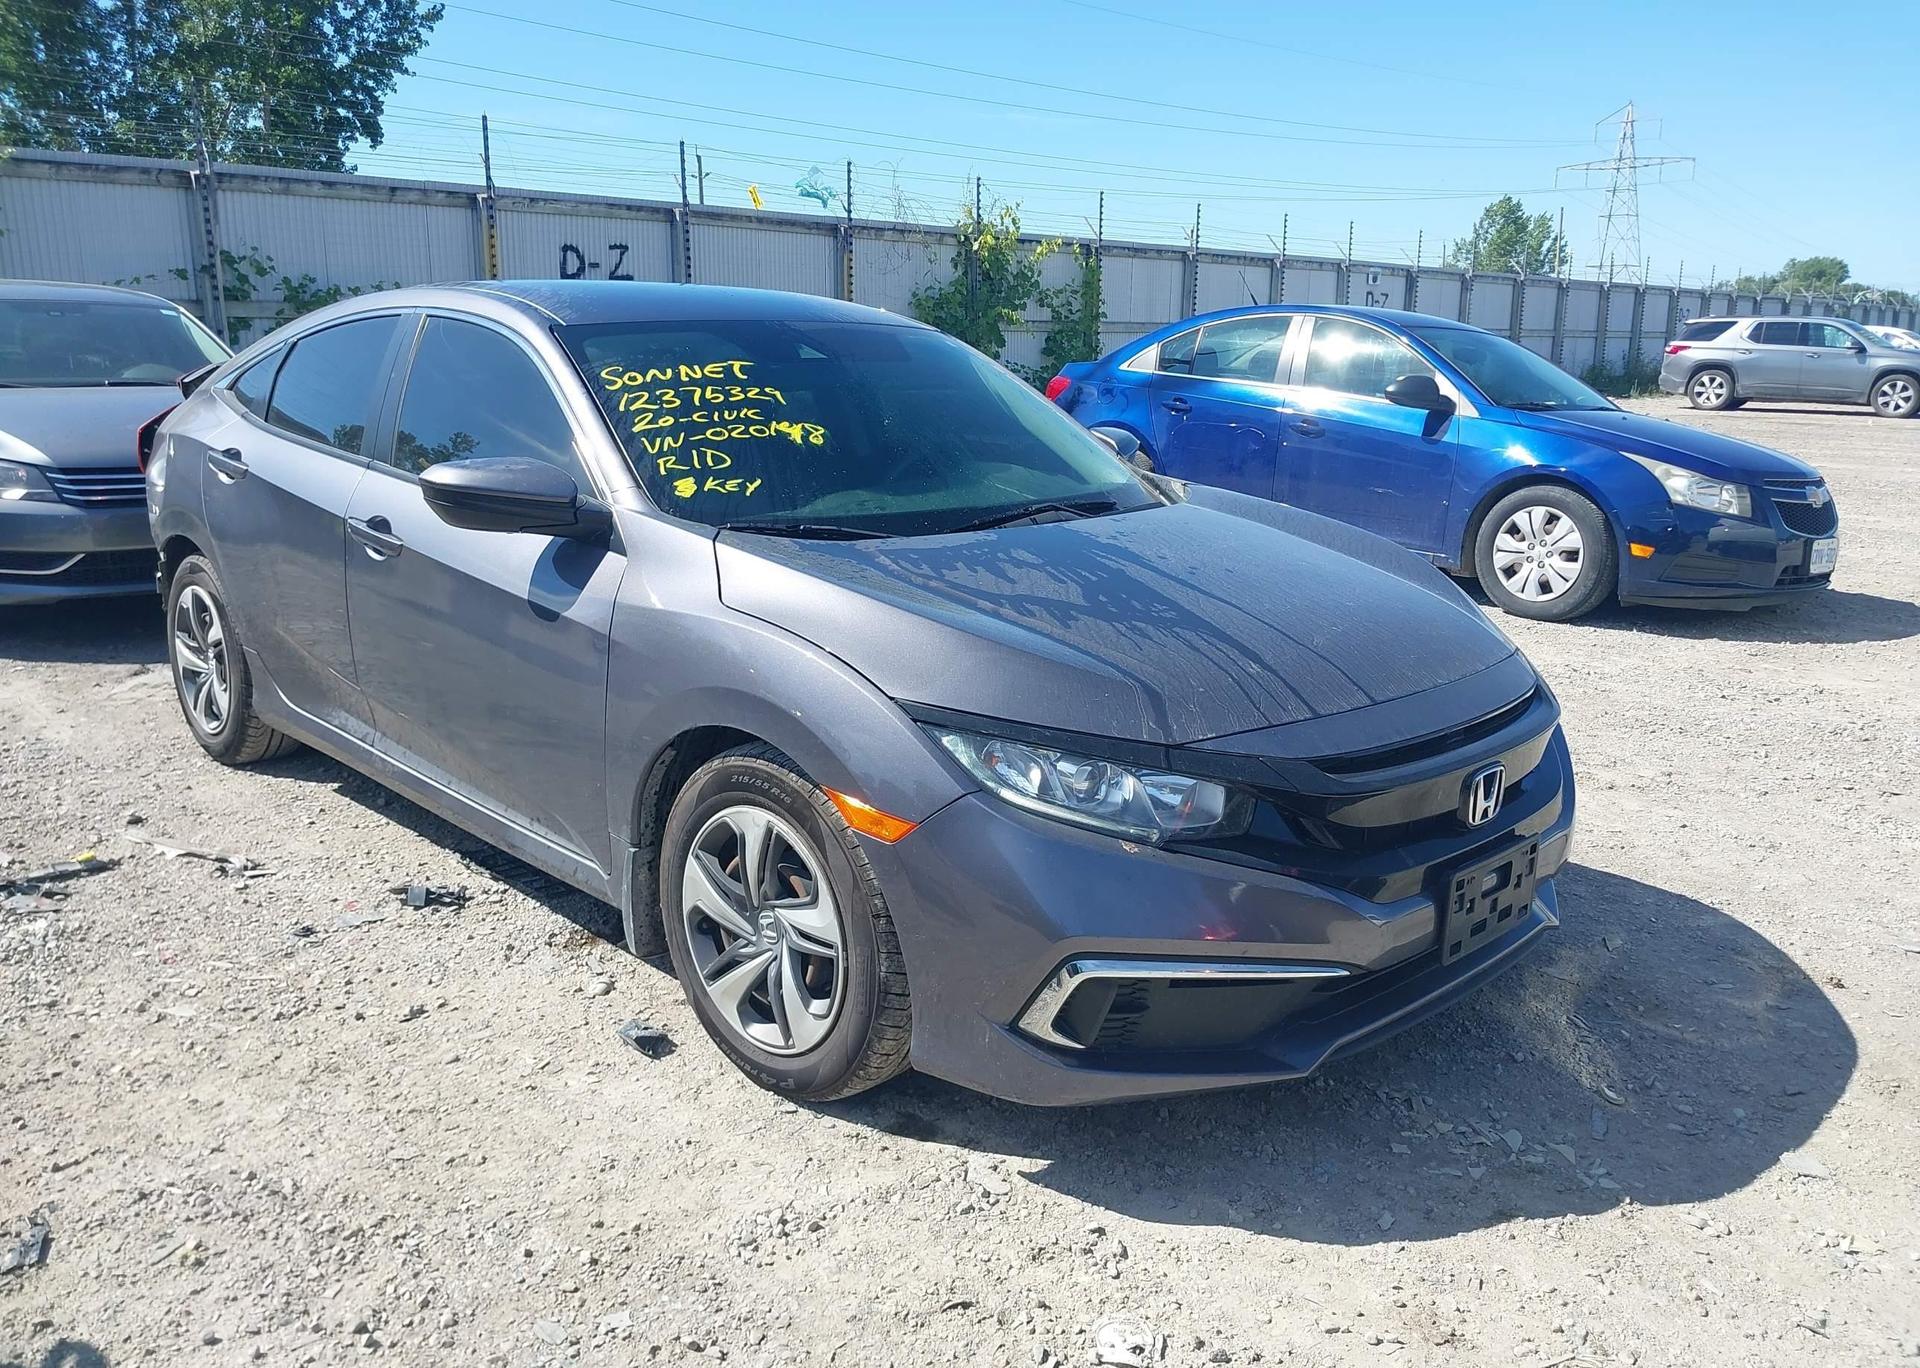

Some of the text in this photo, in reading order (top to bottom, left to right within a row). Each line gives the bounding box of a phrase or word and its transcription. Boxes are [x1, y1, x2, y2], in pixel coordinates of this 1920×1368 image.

[600, 360, 755, 391] SONNET
[618, 386, 787, 412] 12375329
[703, 476, 762, 497] KEY
